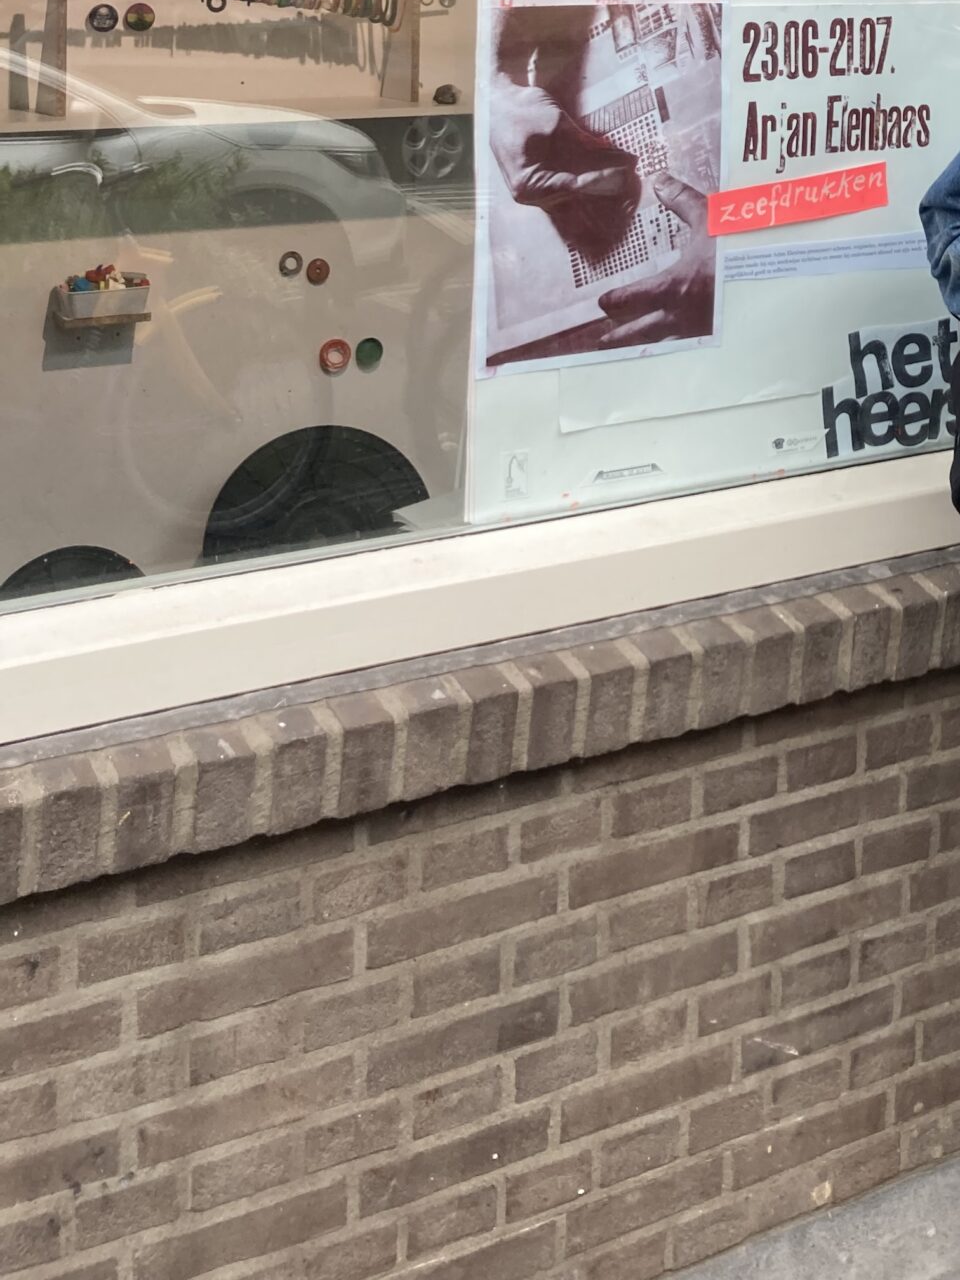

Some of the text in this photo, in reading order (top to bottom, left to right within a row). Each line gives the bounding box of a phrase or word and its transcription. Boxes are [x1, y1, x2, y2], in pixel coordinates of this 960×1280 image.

[742, 100, 817, 174] Arjan
[719, 170, 885, 226] zeefdrukken
[848, 317, 958, 399] het
